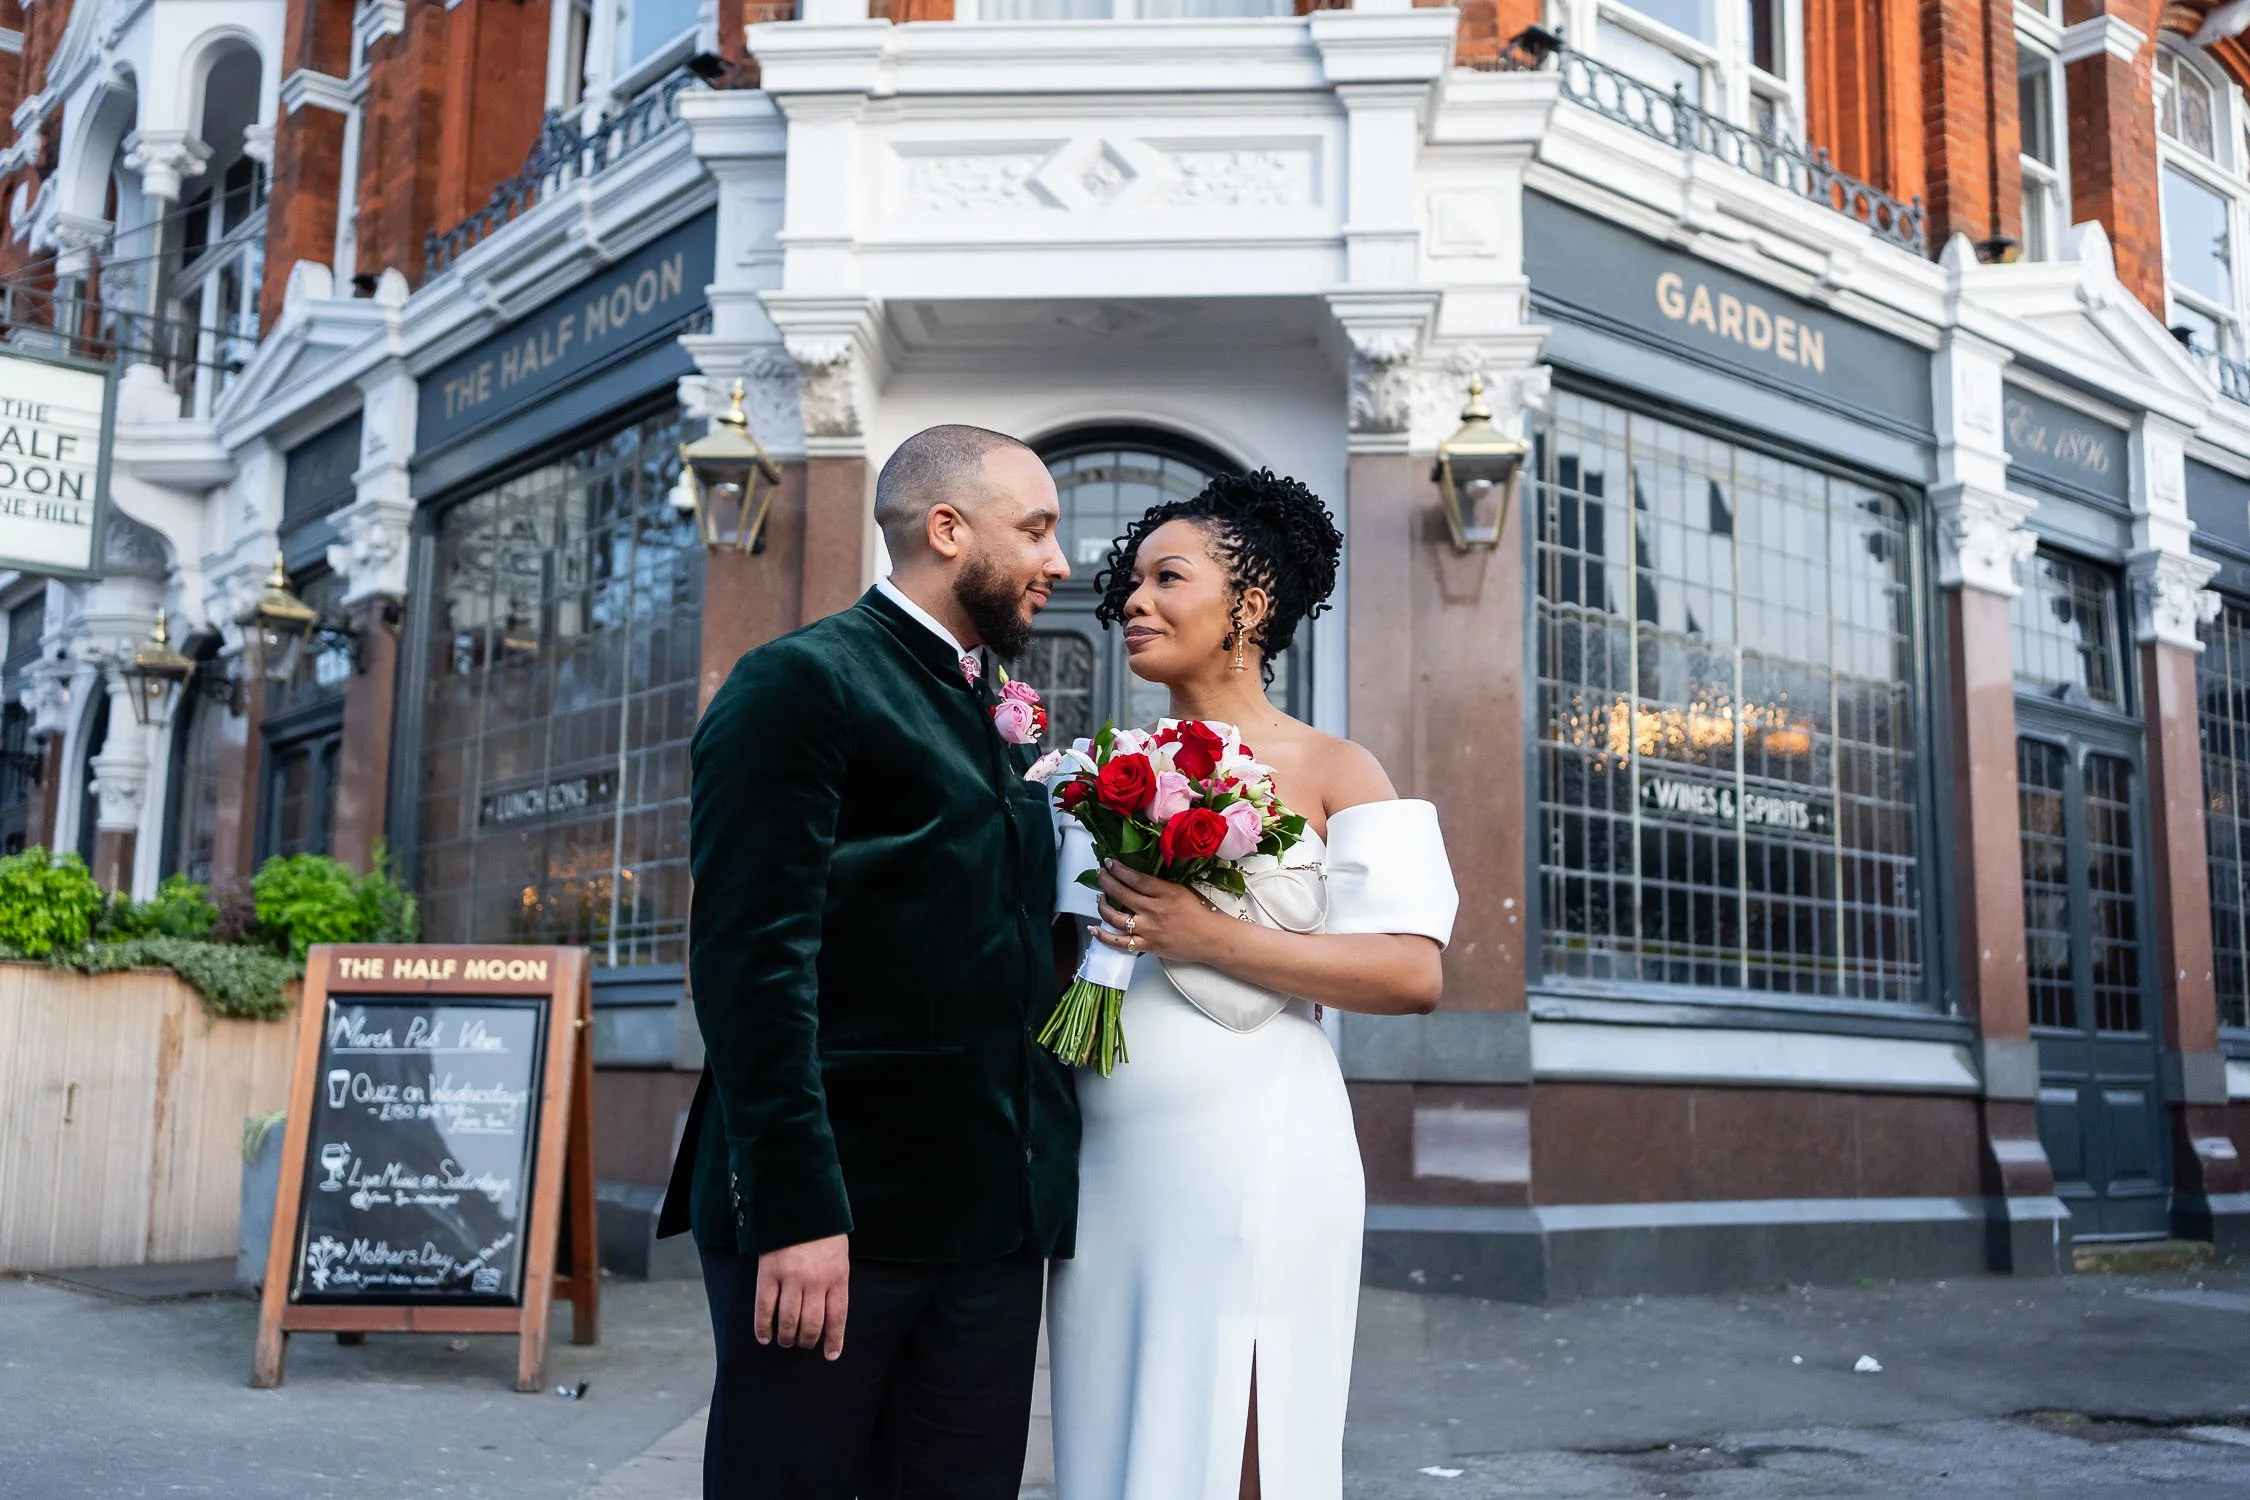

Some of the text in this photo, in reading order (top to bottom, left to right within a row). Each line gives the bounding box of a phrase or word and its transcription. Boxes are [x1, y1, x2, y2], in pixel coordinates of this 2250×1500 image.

[444, 252, 684, 419] THE HALF MOON
[1656, 271, 1825, 374] GARDEN
[2, 396, 50, 424] THE
[0, 425, 78, 461] ALF
[0, 461, 84, 500] OON
[36, 500, 86, 526] HILL
[1653, 778, 1810, 831] WINES & SPIRITS
[338, 957, 548, 982] THE HALF MOON
